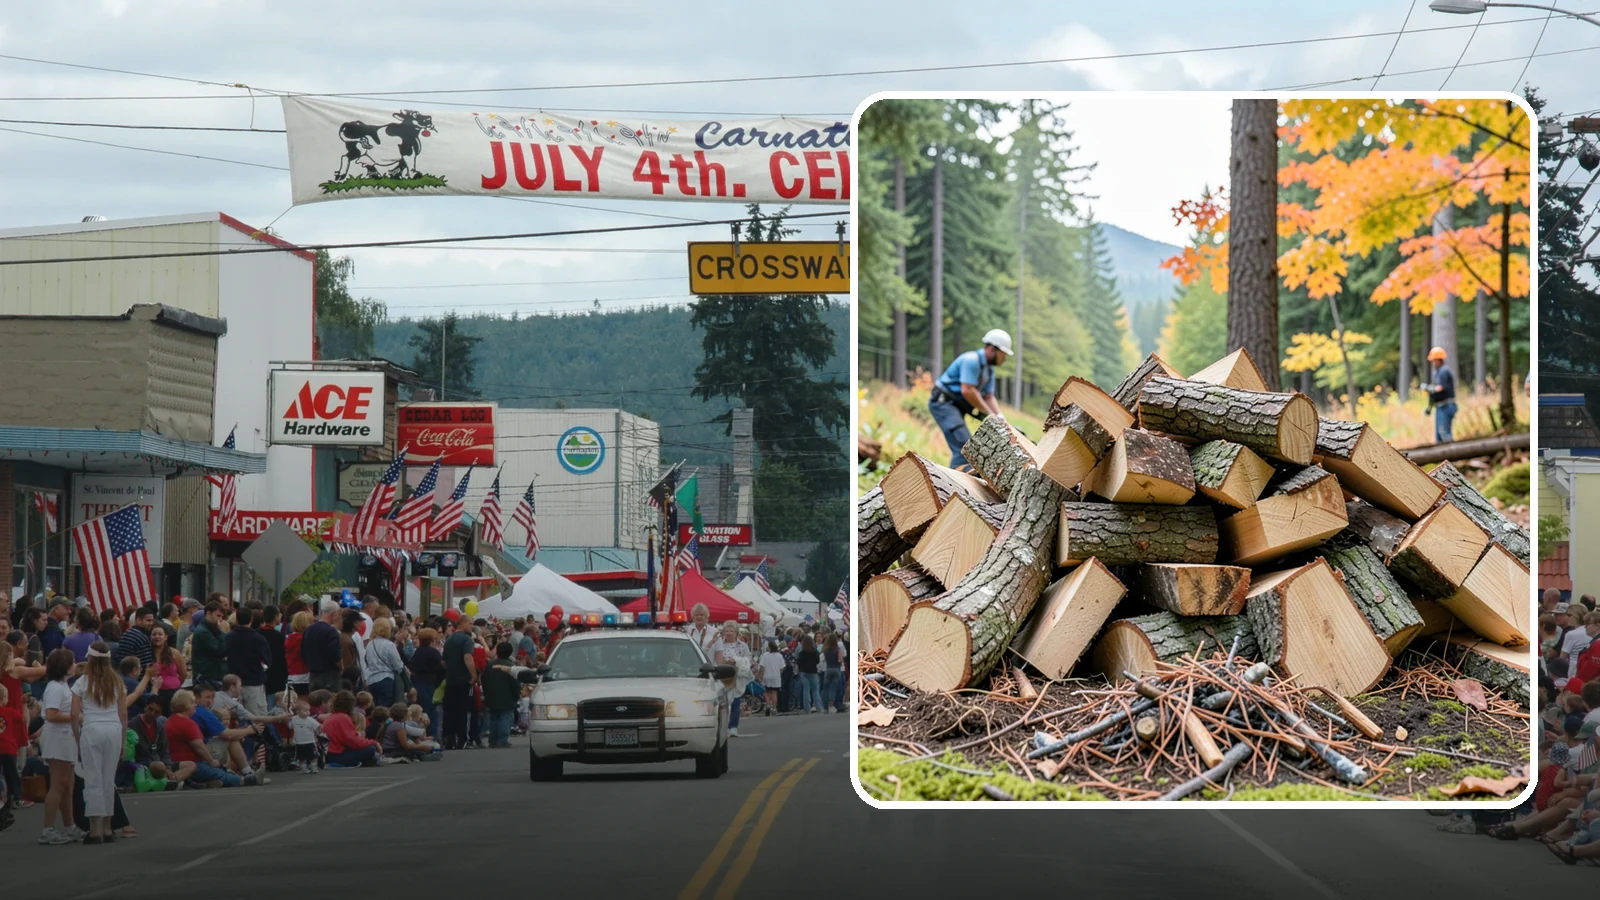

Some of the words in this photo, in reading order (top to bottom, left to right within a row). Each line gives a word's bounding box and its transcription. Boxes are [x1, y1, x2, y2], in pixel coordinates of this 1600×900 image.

[481, 140, 605, 193] JULY
[632, 150, 746, 198] 4th.
[697, 254, 850, 280] CROSSWA
[283, 380, 373, 420] ACE
[406, 409, 453, 422] CEDAR
[461, 409, 485, 422] LOG
[283, 421, 371, 436] Hardware
[416, 428, 477, 447] Coca-Cola
[353, 467, 386, 480] Simpl
[83, 485, 93, 494] St.
[95, 485, 124, 494] Vincent
[126, 486, 136, 494] de
[138, 486, 155, 495] Paul
[81, 503, 153, 521] THT
[212, 516, 331, 535] HARDARE
[688, 526, 741, 535] CRNATION
[699, 535, 730, 543] GLASS
